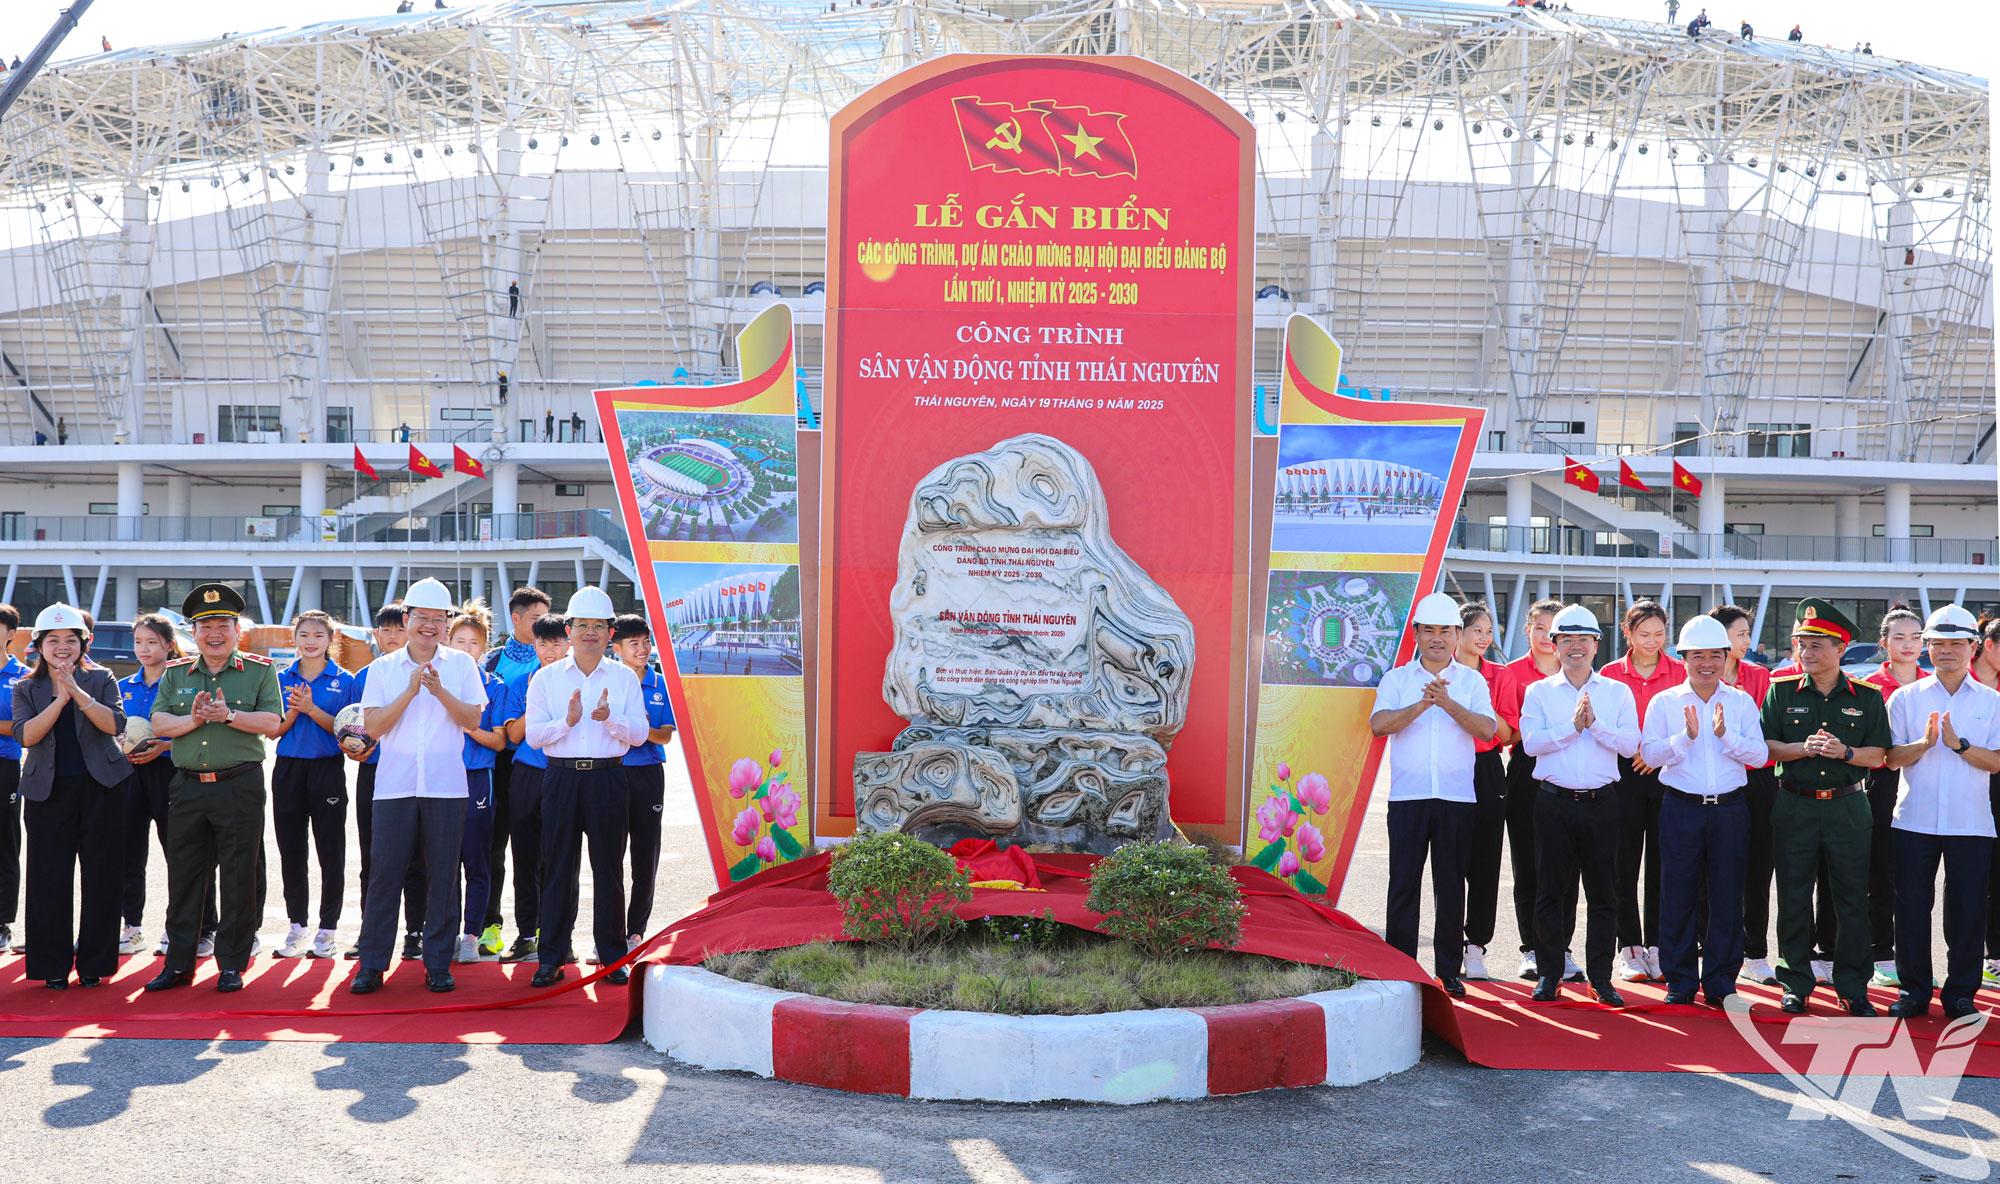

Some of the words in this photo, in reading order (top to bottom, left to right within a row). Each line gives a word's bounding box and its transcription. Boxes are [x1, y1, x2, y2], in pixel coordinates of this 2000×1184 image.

[914, 193, 963, 228] LỄ
[976, 193, 1059, 229] GẮN
[1071, 194, 1171, 231] BIỂN
[858, 238, 881, 265] CÁC
[885, 238, 917, 265] CÔNG
[920, 239, 958, 268] TRÌNH,
[962, 241, 980, 272] DỰ
[981, 240, 998, 266] ÁN
[1001, 240, 1032, 267] CHÀO
[1036, 240, 1071, 268] MỪNG
[1075, 246, 1095, 273] ĐẠI
[1098, 242, 1118, 273] HỘI
[1121, 246, 1141, 273] ĐẠI
[1144, 238, 1171, 269] BIỂU
[1174, 240, 1207, 269] ĐẢNG
[1211, 243, 1227, 274] BỘ
[944, 273, 968, 303] LẦN
[971, 276, 995, 303] THỨ
[997, 281, 1005, 305] I,
[1008, 277, 1047, 308] NHIỆM
[1050, 277, 1066, 304] KỲ
[1069, 282, 1098, 304] 2025
[1109, 282, 1138, 305] 2030
[957, 321, 1031, 344] CÔNG
[1039, 323, 1123, 345] TRÌNH
[860, 352, 900, 379] SÂN
[905, 353, 948, 384] VẬN
[953, 354, 1014, 385] ĐỘNG
[1019, 353, 1070, 381] TỈNH
[1076, 356, 1127, 382] THÁI
[1132, 357, 1220, 383] NGUYÊN
[914, 394, 942, 407] THÁI
[944, 395, 998, 409] NGUYÊN,
[1001, 395, 1036, 407] NGÀY
[1038, 398, 1050, 408] 19
[1053, 396, 1094, 409] THÁNG
[1097, 400, 1104, 409] 9
[1107, 397, 1134, 410] NĂM
[1137, 400, 1164, 410] 2025
[1004, 570, 1020, 578] 2025
